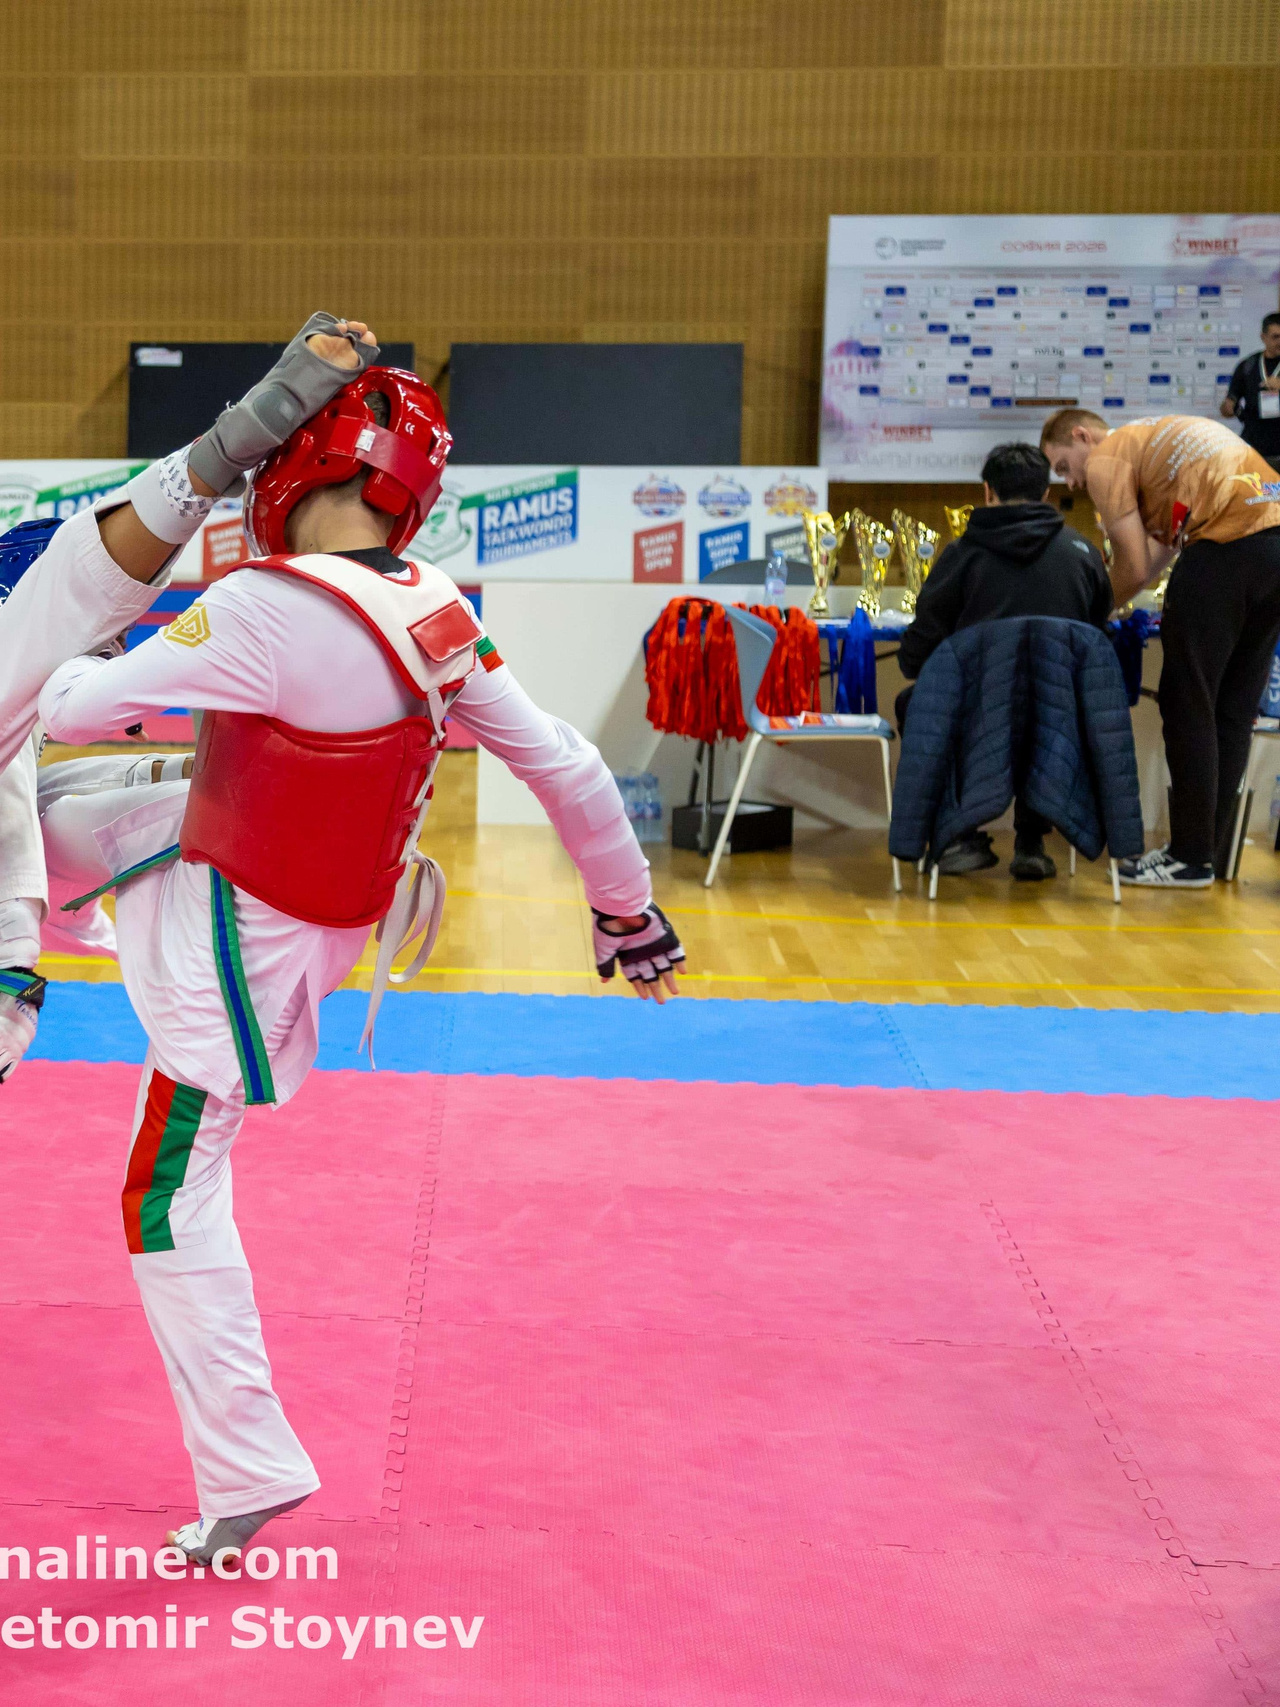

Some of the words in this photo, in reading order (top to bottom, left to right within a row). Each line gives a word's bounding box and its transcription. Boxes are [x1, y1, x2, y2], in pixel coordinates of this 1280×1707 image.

[1188, 238, 1239, 249] WINBET
[884, 425, 932, 437] WINBET
[483, 486, 574, 531] RAMUS
[483, 512, 573, 547] TAEKWONDO
[483, 531, 572, 563] TOURNAMENTS
